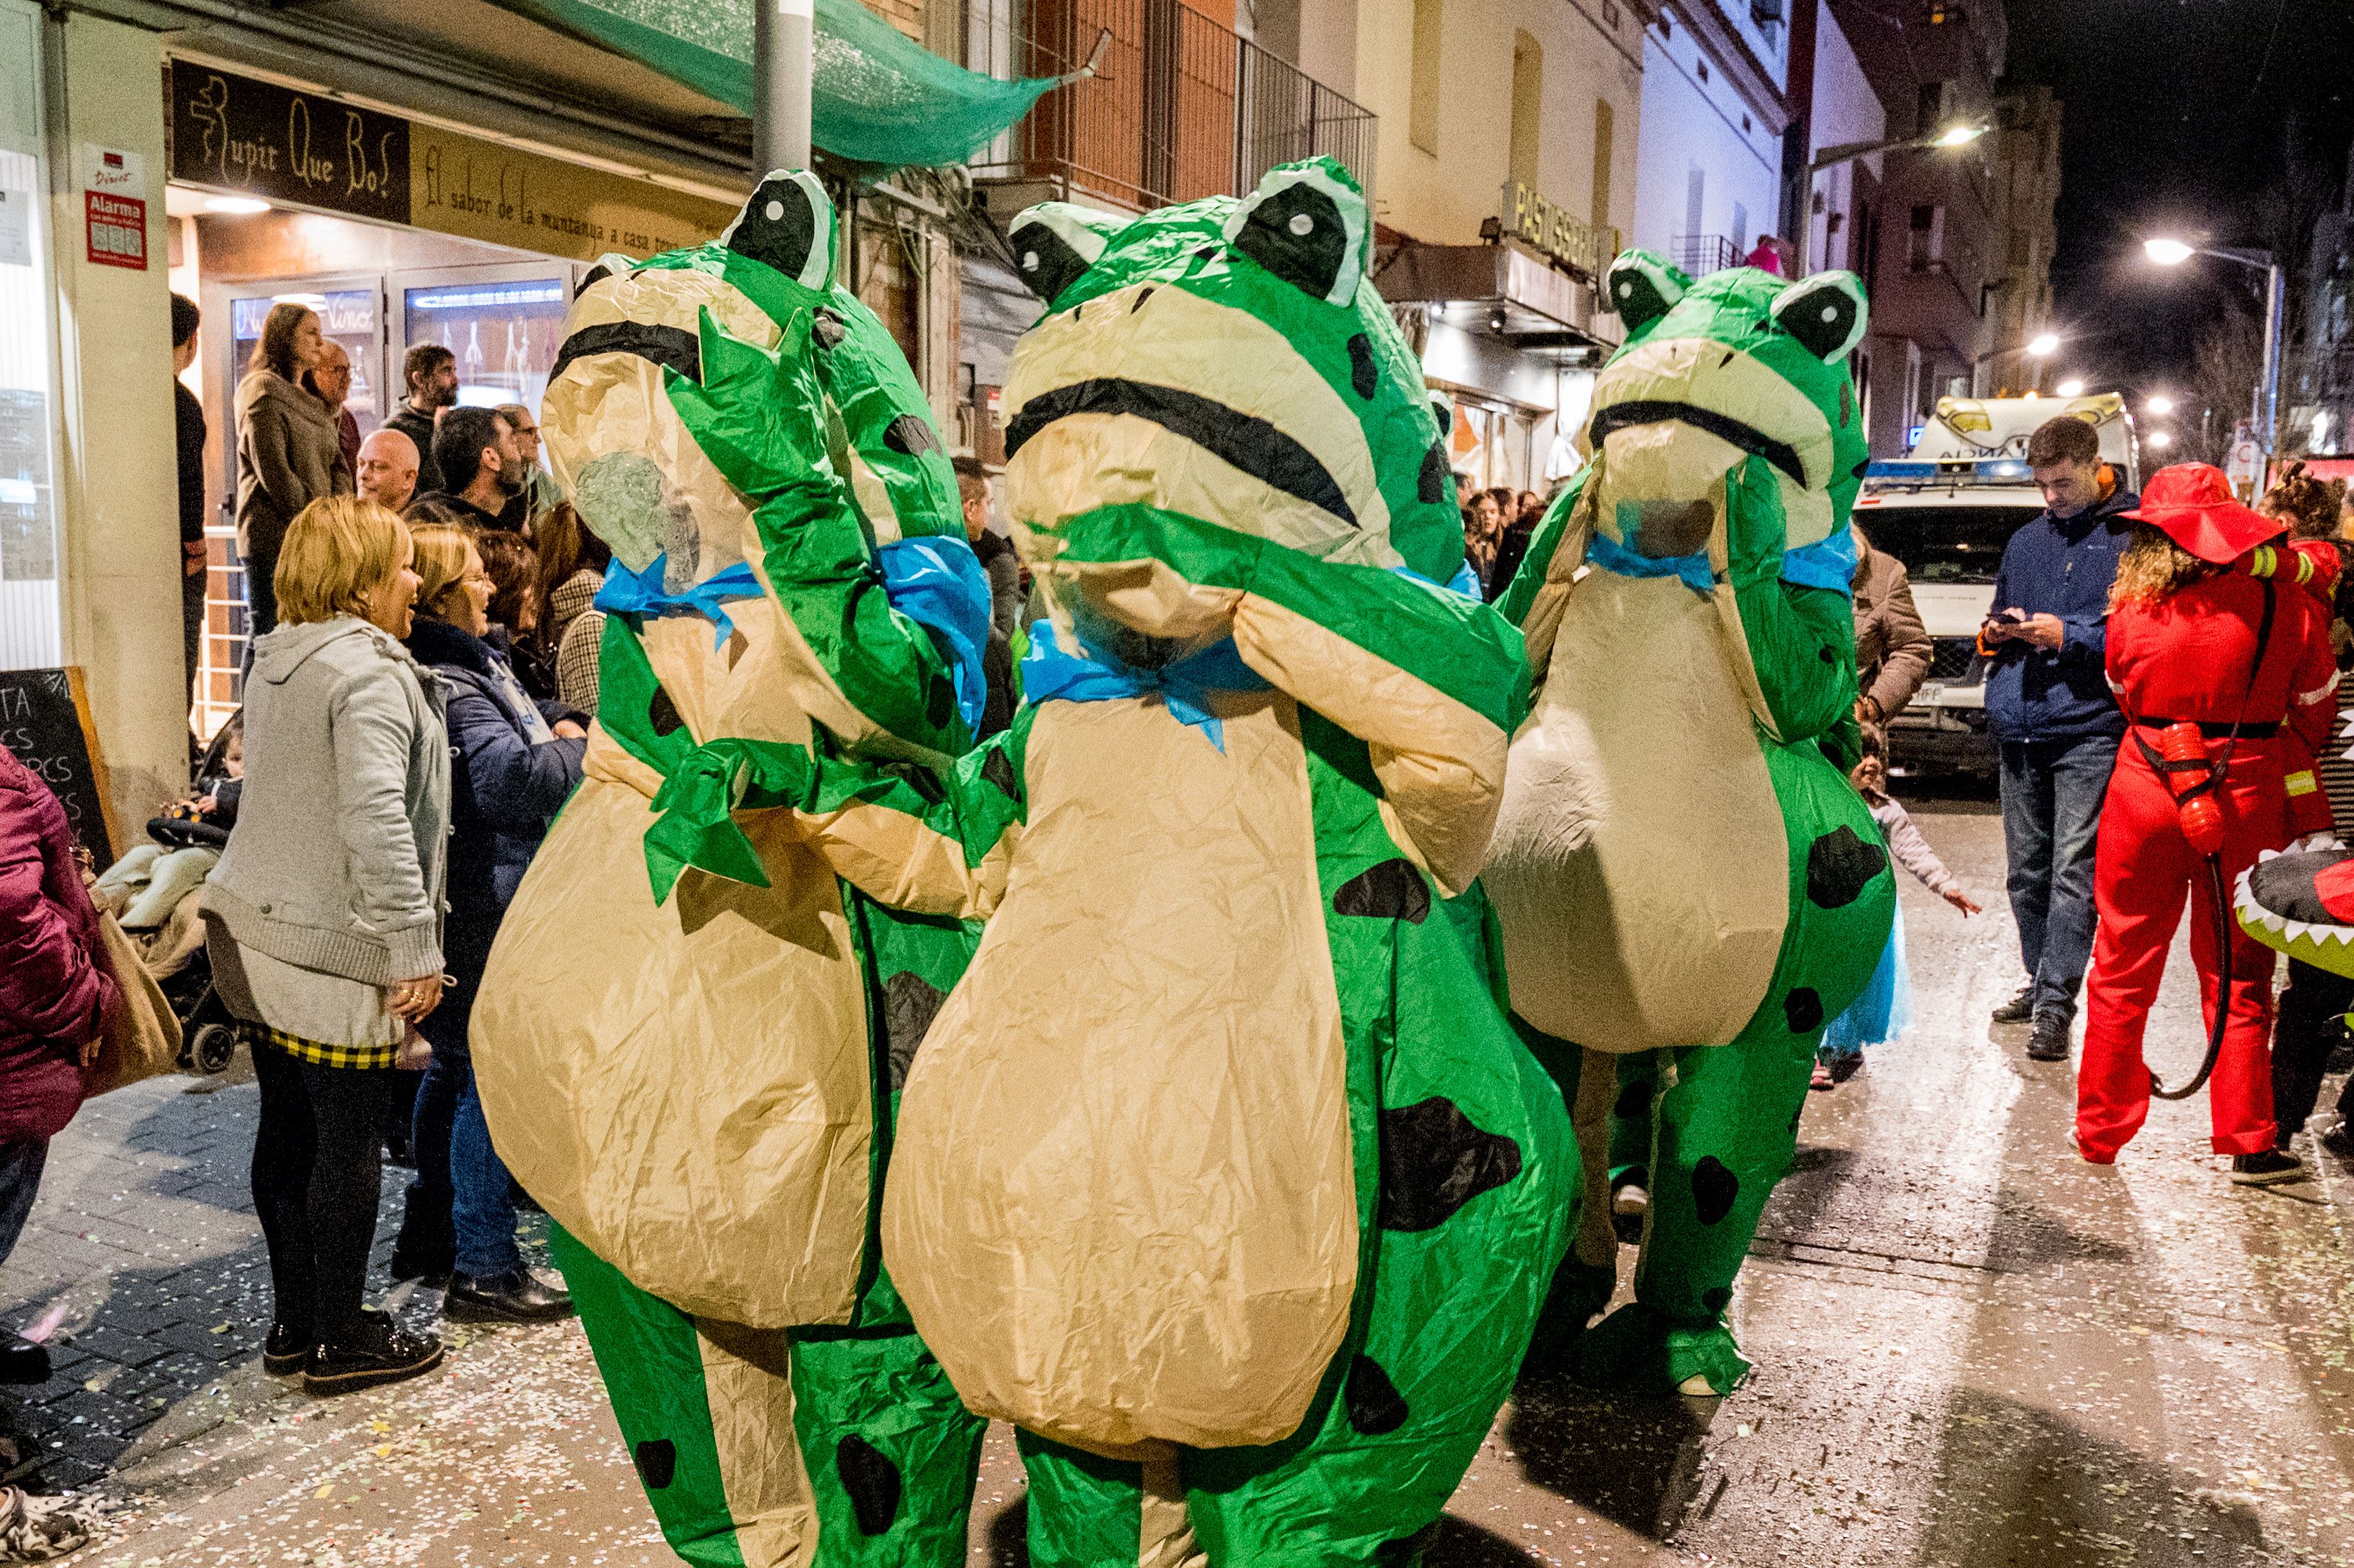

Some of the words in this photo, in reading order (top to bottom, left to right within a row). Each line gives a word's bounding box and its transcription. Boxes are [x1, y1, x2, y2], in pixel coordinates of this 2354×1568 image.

[290, 98, 334, 188] Que
[91, 195, 141, 218] Alarma
[426, 144, 443, 207] El
[451, 156, 491, 214] sabor
[498, 162, 514, 220] de
[520, 172, 535, 225] la
[610, 229, 618, 243] a
[325, 292, 373, 329] Vino
